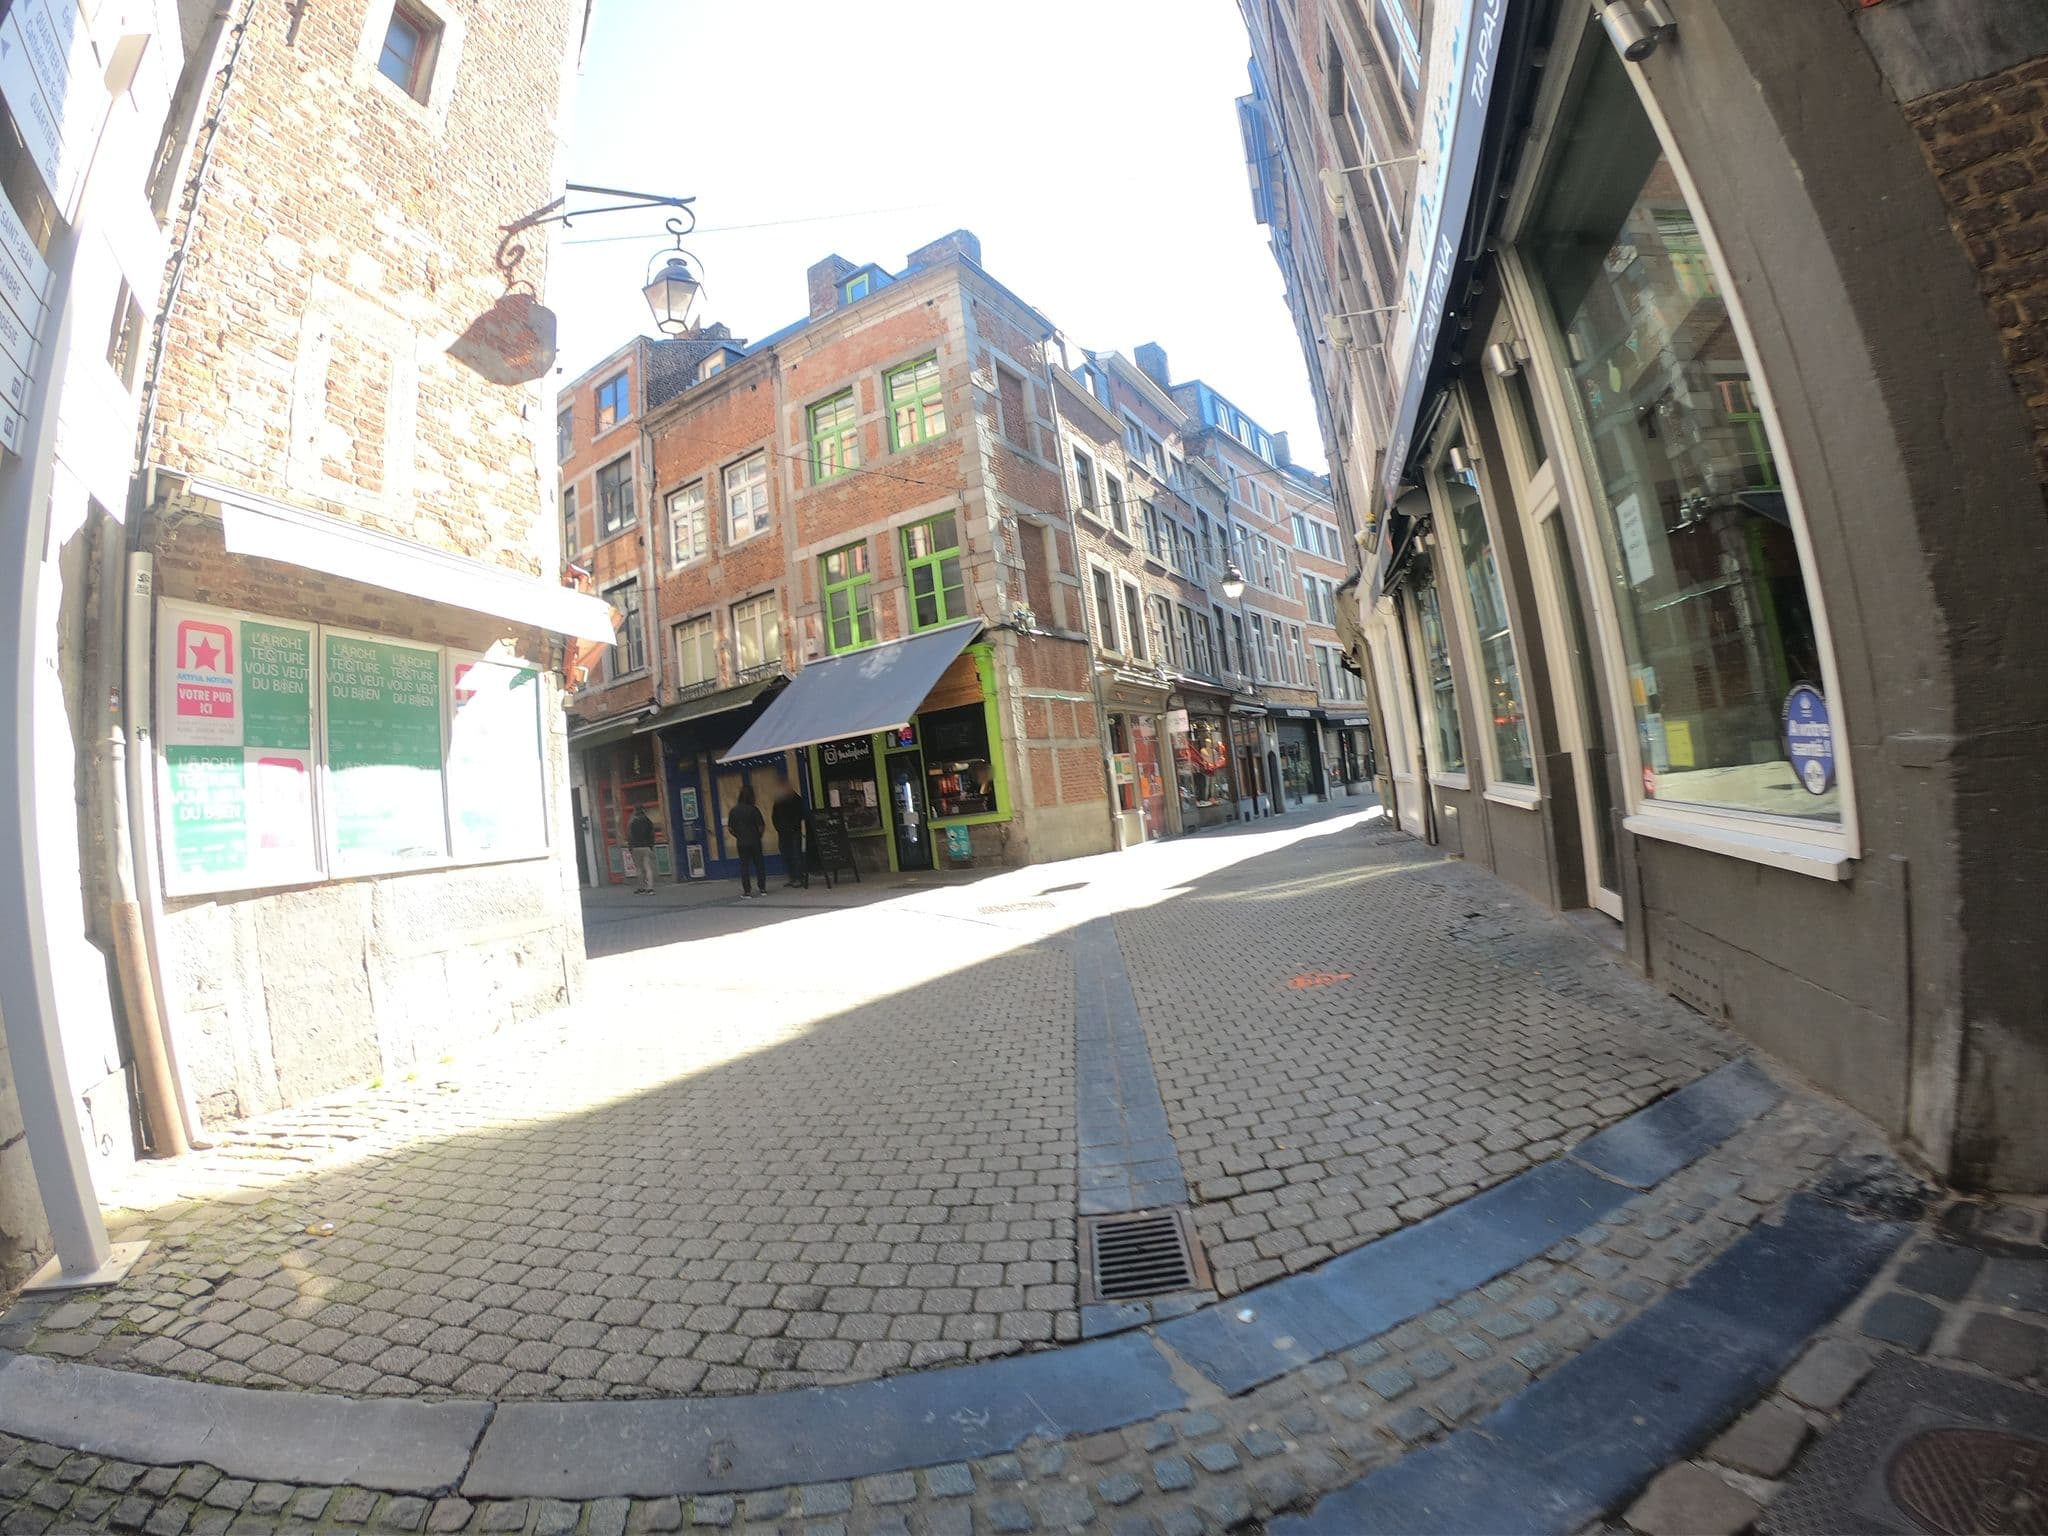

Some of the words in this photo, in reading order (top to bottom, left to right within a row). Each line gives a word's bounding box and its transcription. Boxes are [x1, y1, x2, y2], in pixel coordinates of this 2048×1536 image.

[0, 257, 21, 302] AMBRE
[1415, 343, 1427, 382] LA
[1423, 233, 1453, 351] CANTINA
[244, 661, 279, 677] VOUS
[281, 665, 311, 681] VEUT
[252, 676, 270, 691] DU
[326, 671, 357, 685] VOUS
[360, 676, 385, 687] VEUT
[387, 679, 413, 692] VOUS
[179, 687, 210, 702] VOTRE
[213, 691, 233, 704] PUB
[332, 686, 349, 698] DU
[393, 692, 407, 705] DU
[200, 702, 213, 714] ICI
